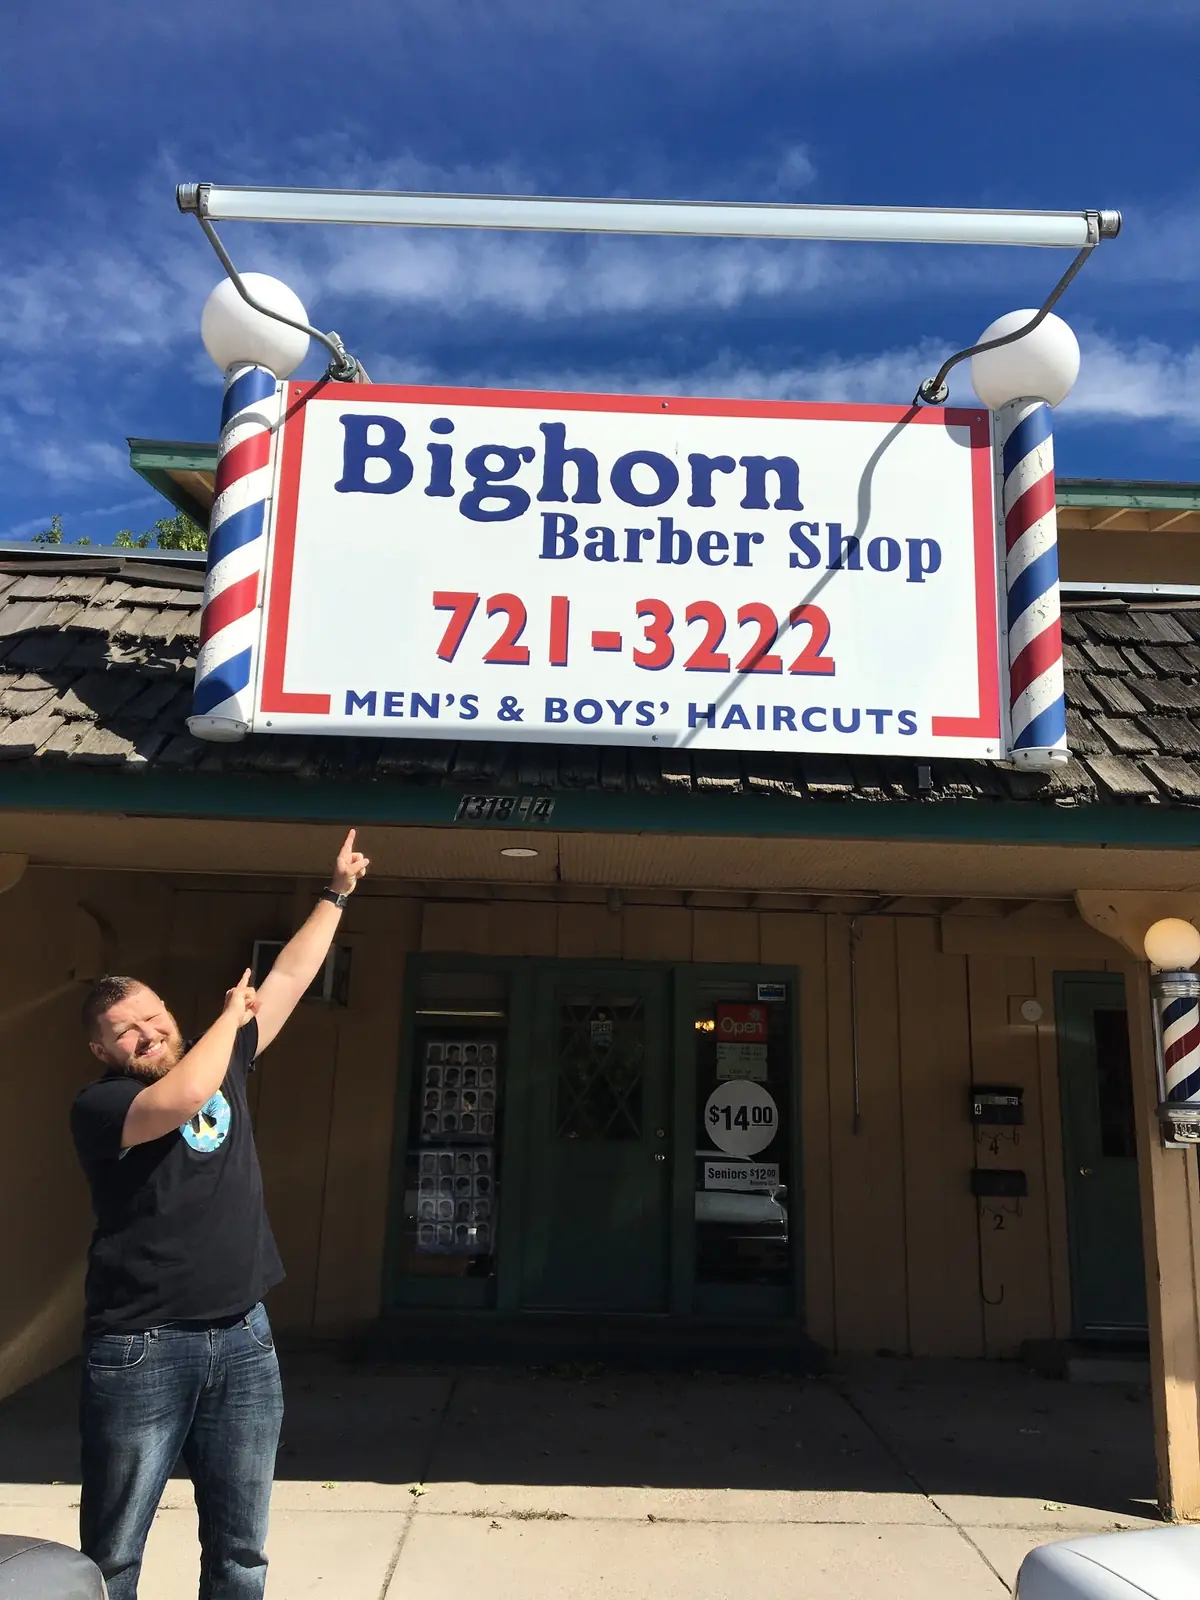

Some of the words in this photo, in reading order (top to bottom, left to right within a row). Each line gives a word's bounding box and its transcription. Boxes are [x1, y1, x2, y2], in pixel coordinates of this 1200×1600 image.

[334, 414, 804, 522] Bighorn
[538, 512, 765, 567] Barber
[788, 521, 942, 583] Shop
[432, 590, 836, 677] 721-3222
[344, 690, 479, 719] MEN'S
[497, 695, 525, 722] &
[544, 697, 670, 727] BOYS'
[687, 702, 919, 736] HAIRCUTS
[721, 1016, 763, 1037] Open
[989, 1139, 999, 1155] 4
[708, 1167, 748, 1180] Seniors
[993, 1213, 1005, 1230] 2
